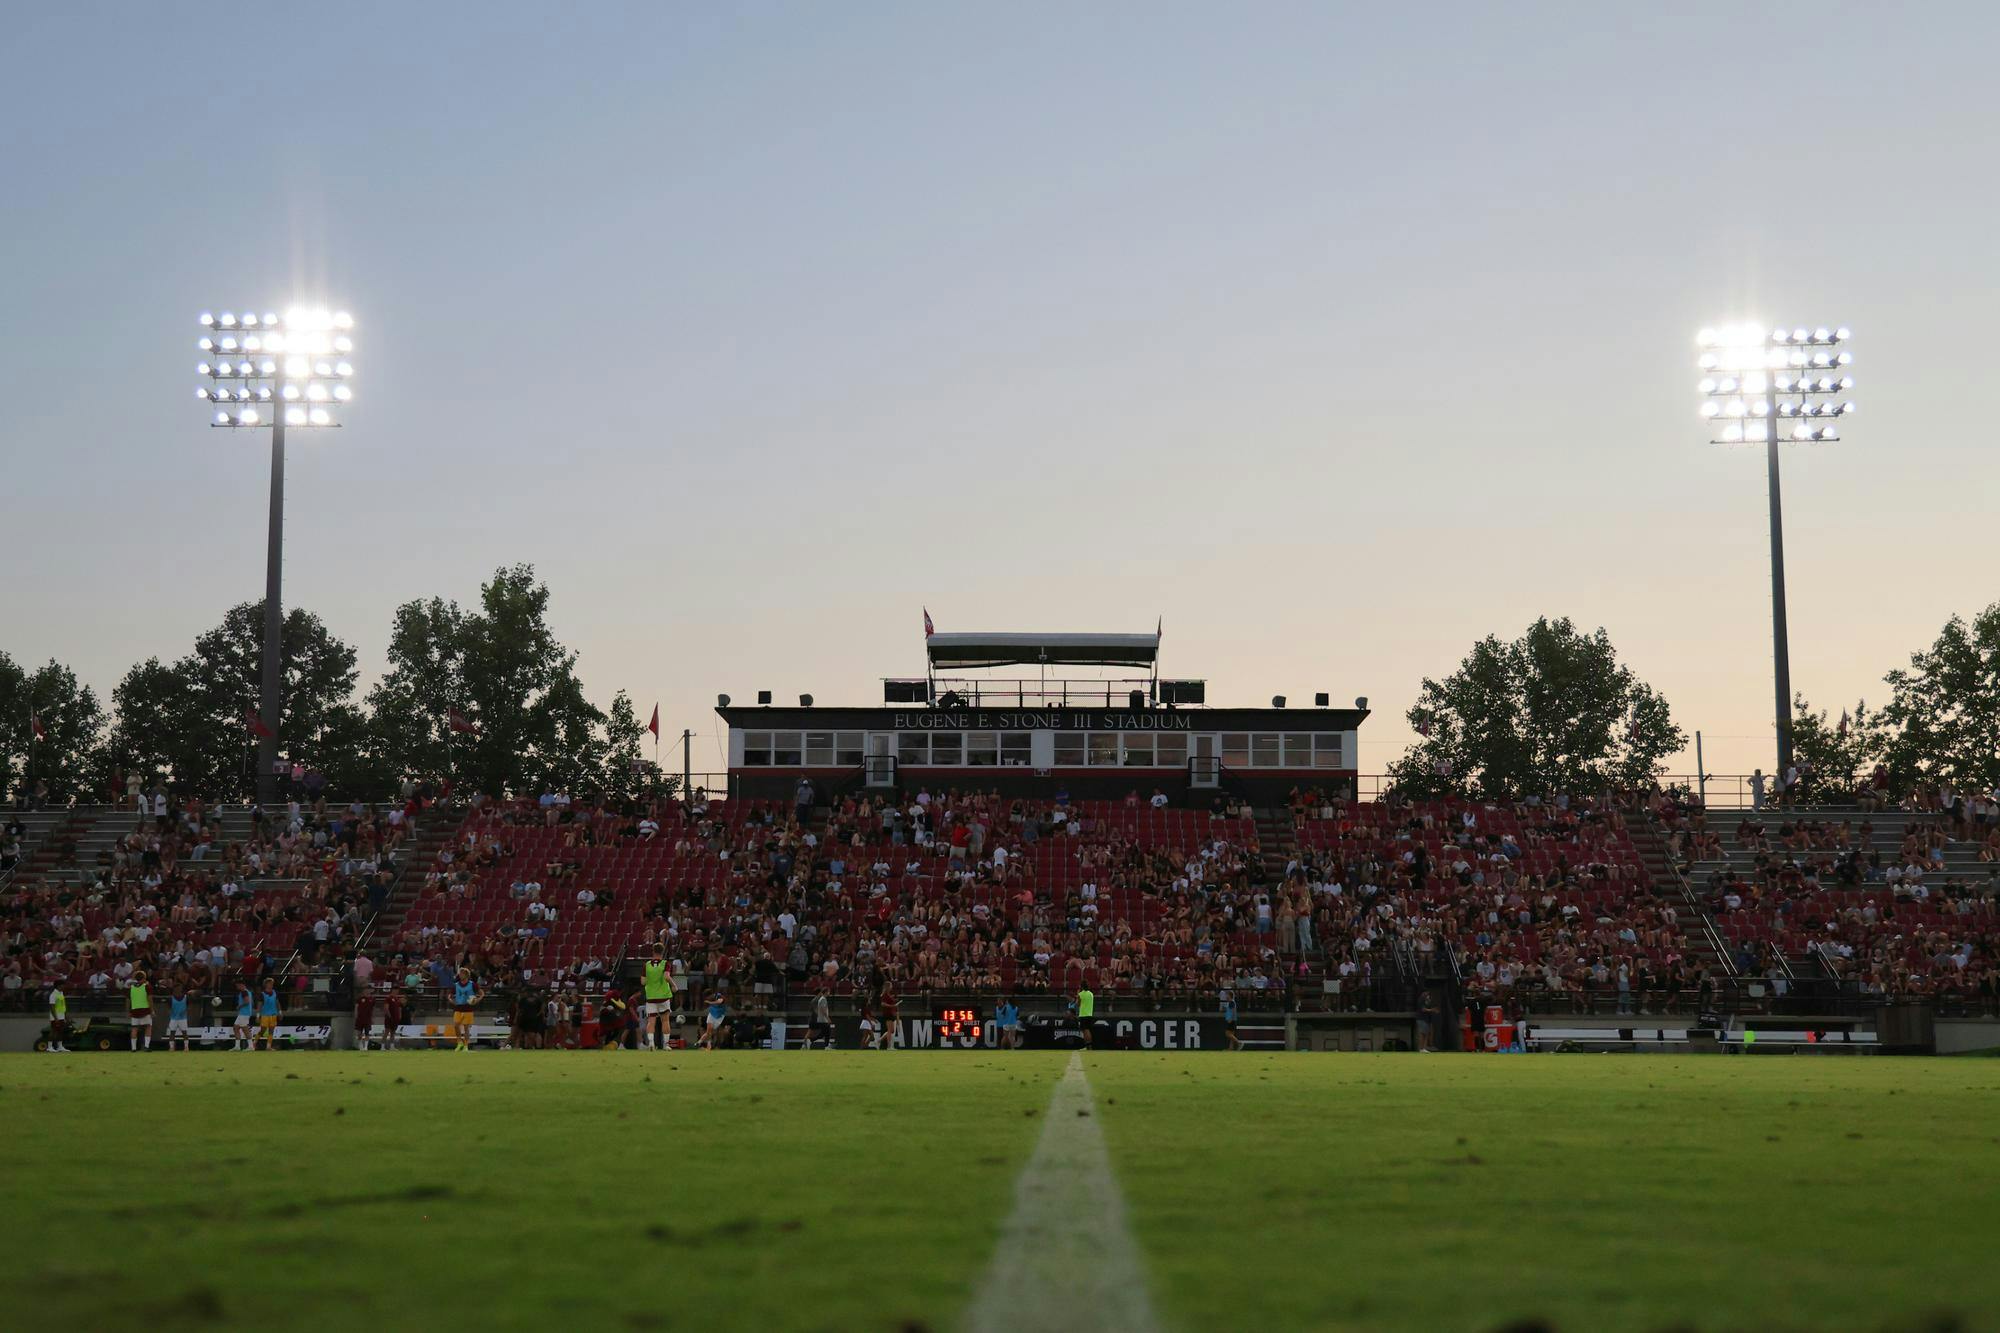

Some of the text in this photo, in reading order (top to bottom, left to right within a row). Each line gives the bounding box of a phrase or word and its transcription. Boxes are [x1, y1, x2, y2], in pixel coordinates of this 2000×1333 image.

[895, 713, 1191, 729] EUGENE E. STONE III STADIUM
[941, 1022, 980, 1037] 4 2 0
